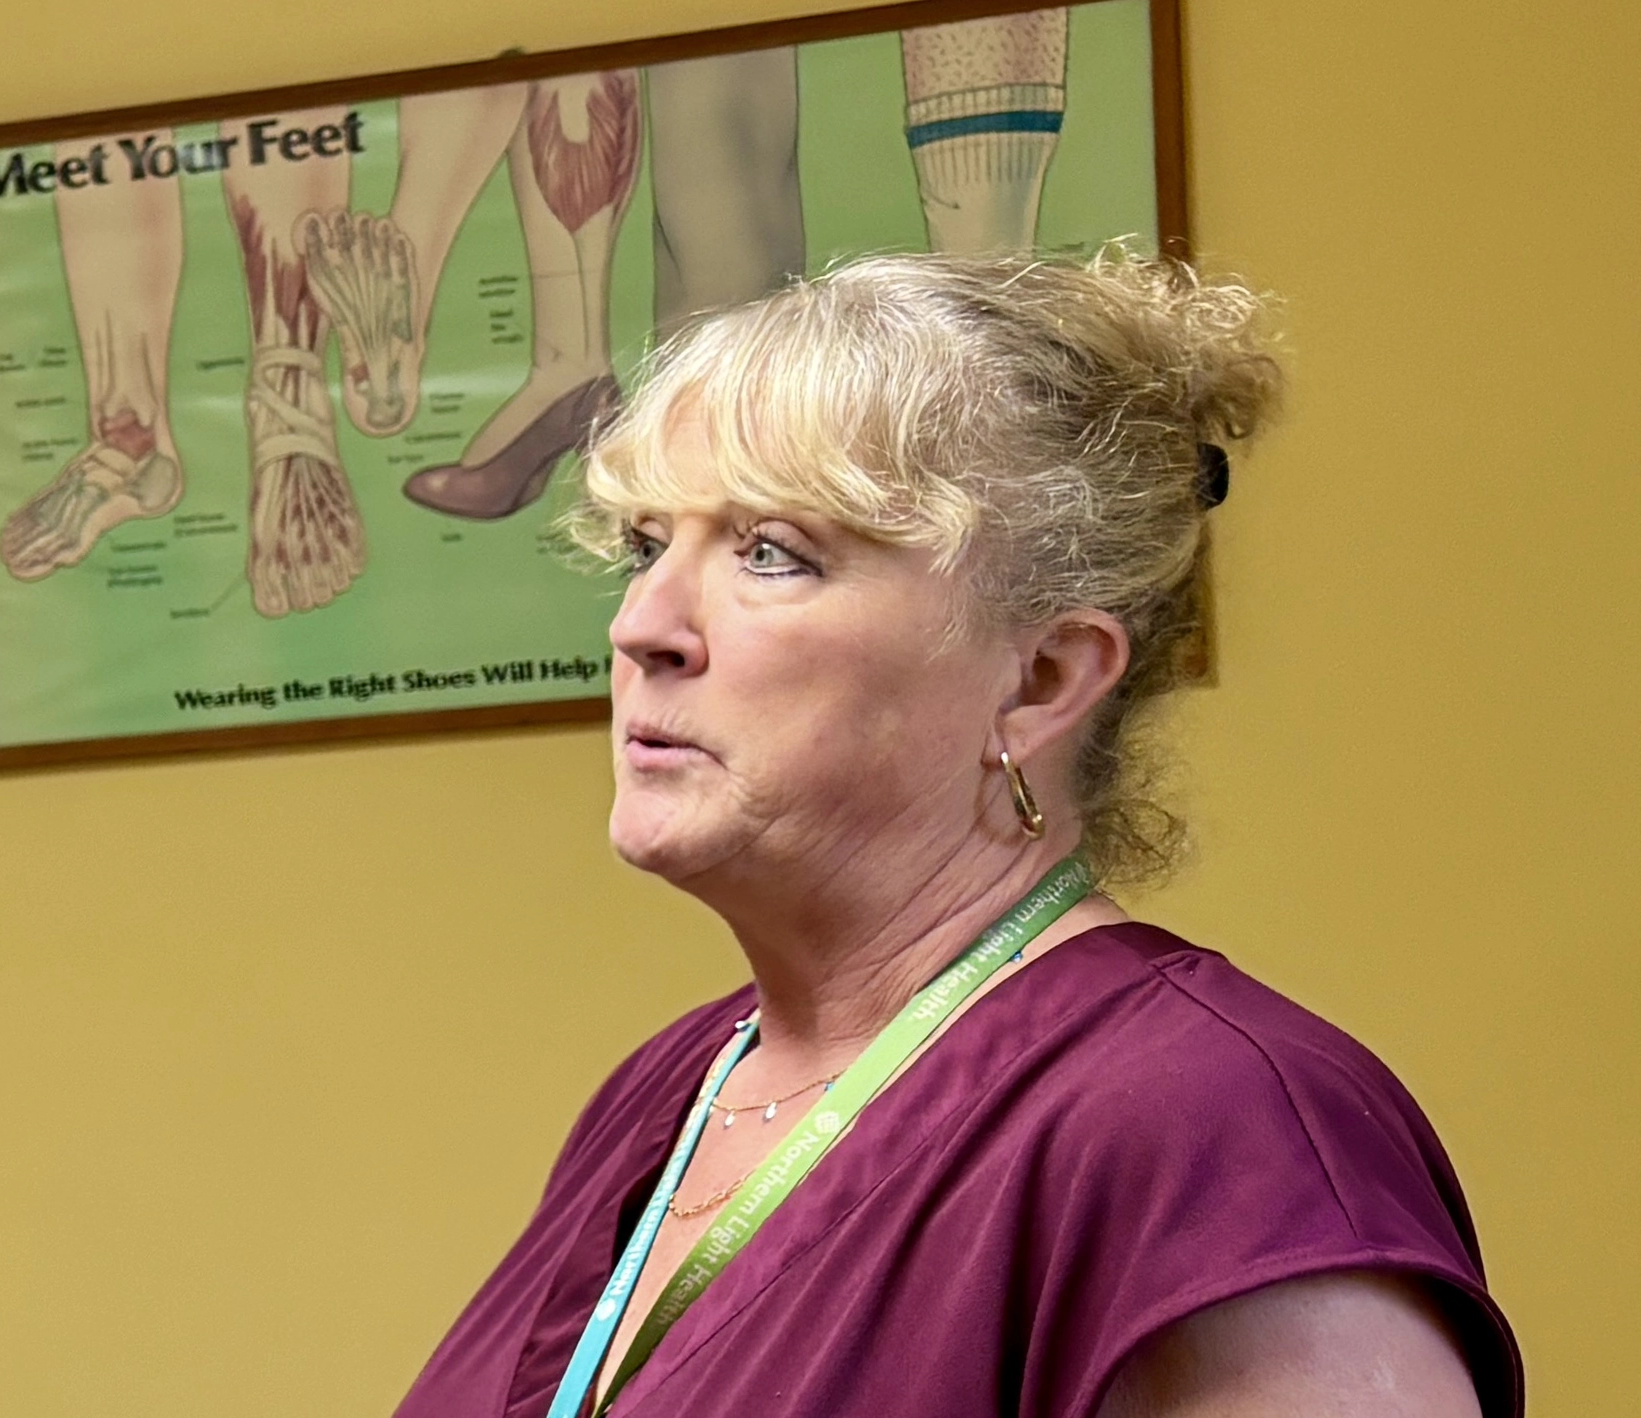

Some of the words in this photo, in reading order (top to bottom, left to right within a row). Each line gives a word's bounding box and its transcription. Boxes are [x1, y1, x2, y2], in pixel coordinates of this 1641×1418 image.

[118, 134, 238, 182] Your
[247, 111, 365, 166] Feet
[174, 682, 278, 710] Wearing
[283, 678, 324, 701] the
[328, 673, 396, 703] Right
[401, 669, 476, 693] Shoes
[480, 660, 534, 685] Will
[539, 655, 599, 682] Help
[970, 921, 1023, 964] Light
[739, 1130, 819, 1215] Northern
[702, 1215, 750, 1264] Light
[656, 1264, 713, 1326] Health
